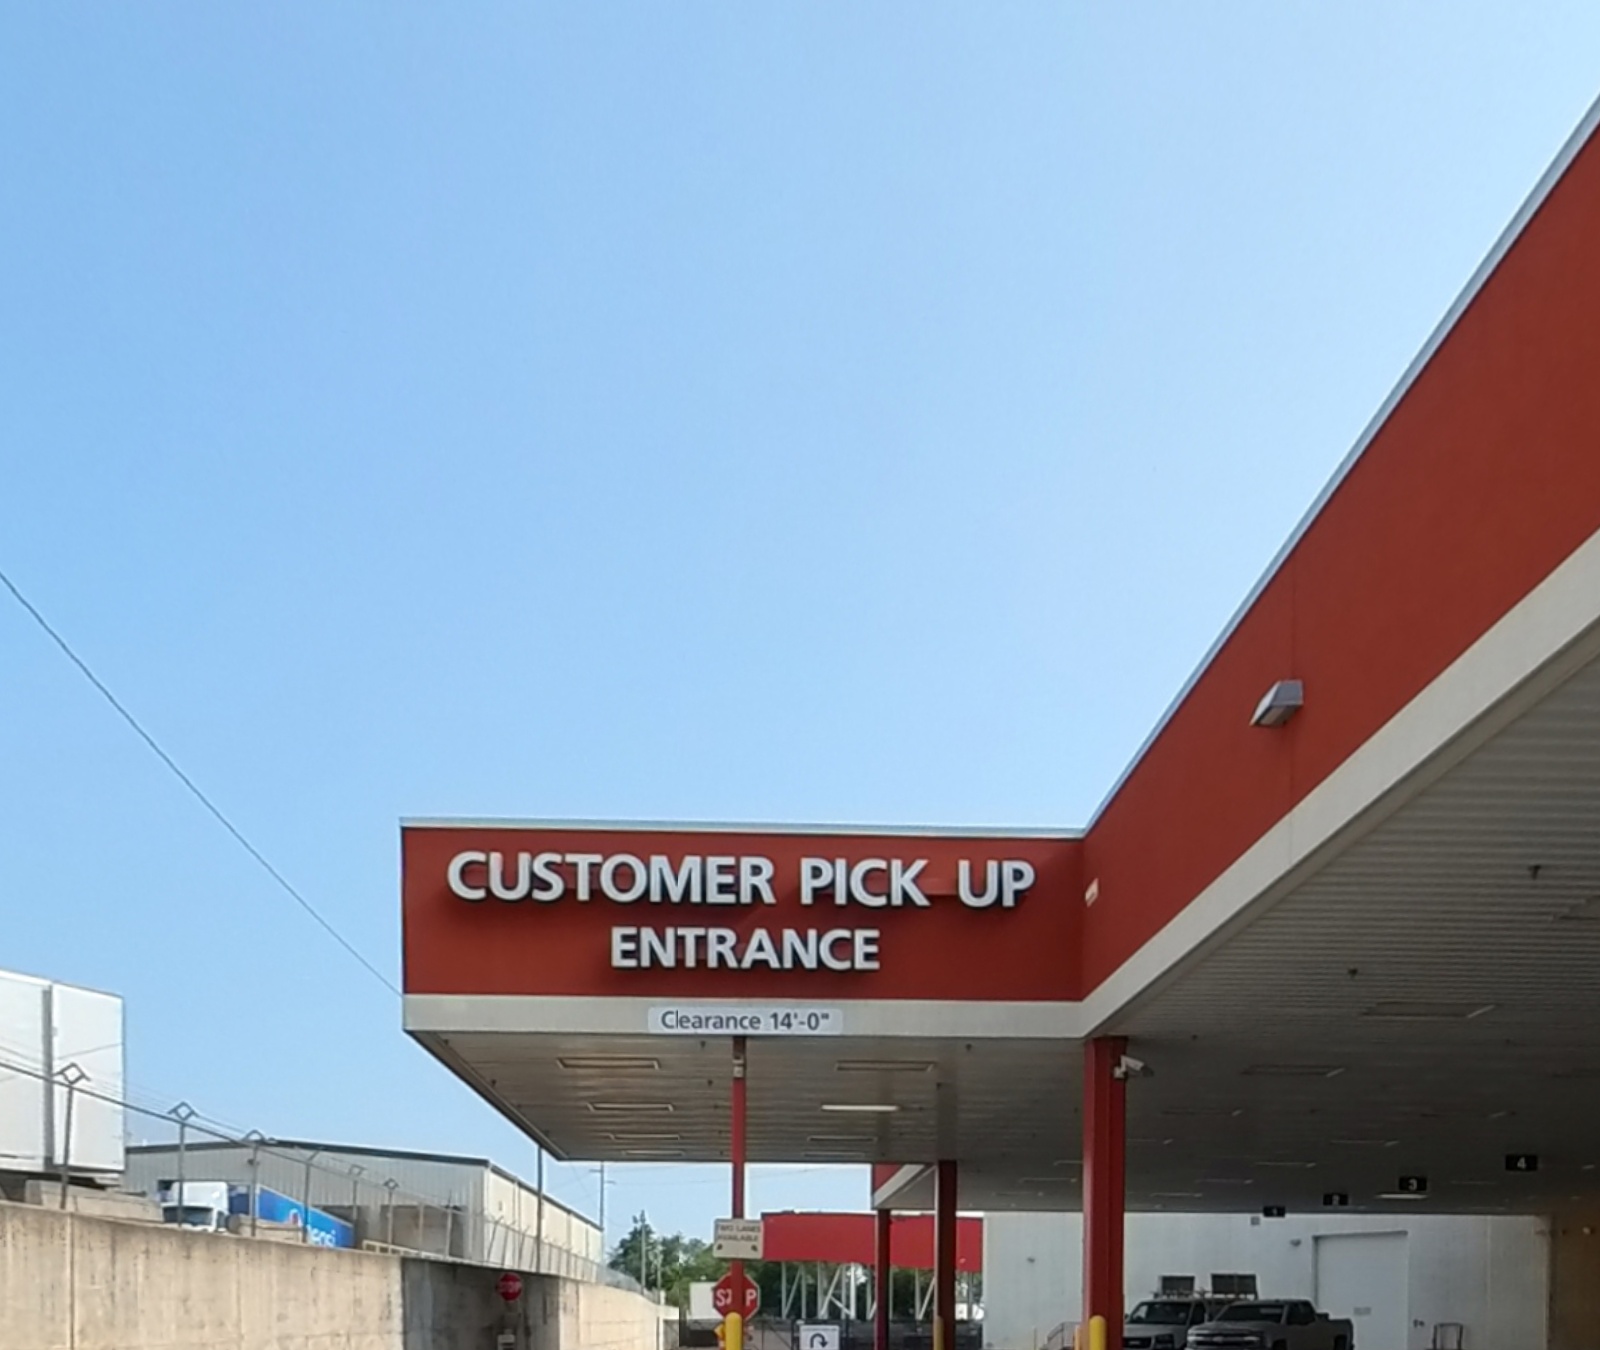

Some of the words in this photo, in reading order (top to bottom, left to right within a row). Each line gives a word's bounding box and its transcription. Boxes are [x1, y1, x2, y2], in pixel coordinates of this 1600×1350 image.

[446, 850, 776, 905] CUSTOMER
[799, 857, 930, 908] PICK
[956, 859, 1035, 908] UP
[610, 926, 881, 971] ENTRANCE
[660, 1010, 762, 1030] Clearance
[769, 1012, 830, 1031] 14'-0"
[1516, 1156, 1527, 1169] 4
[1408, 1178, 1418, 1191] 3
[717, 1234, 759, 1242] AVAILABLE
[716, 1288, 756, 1307] STP
